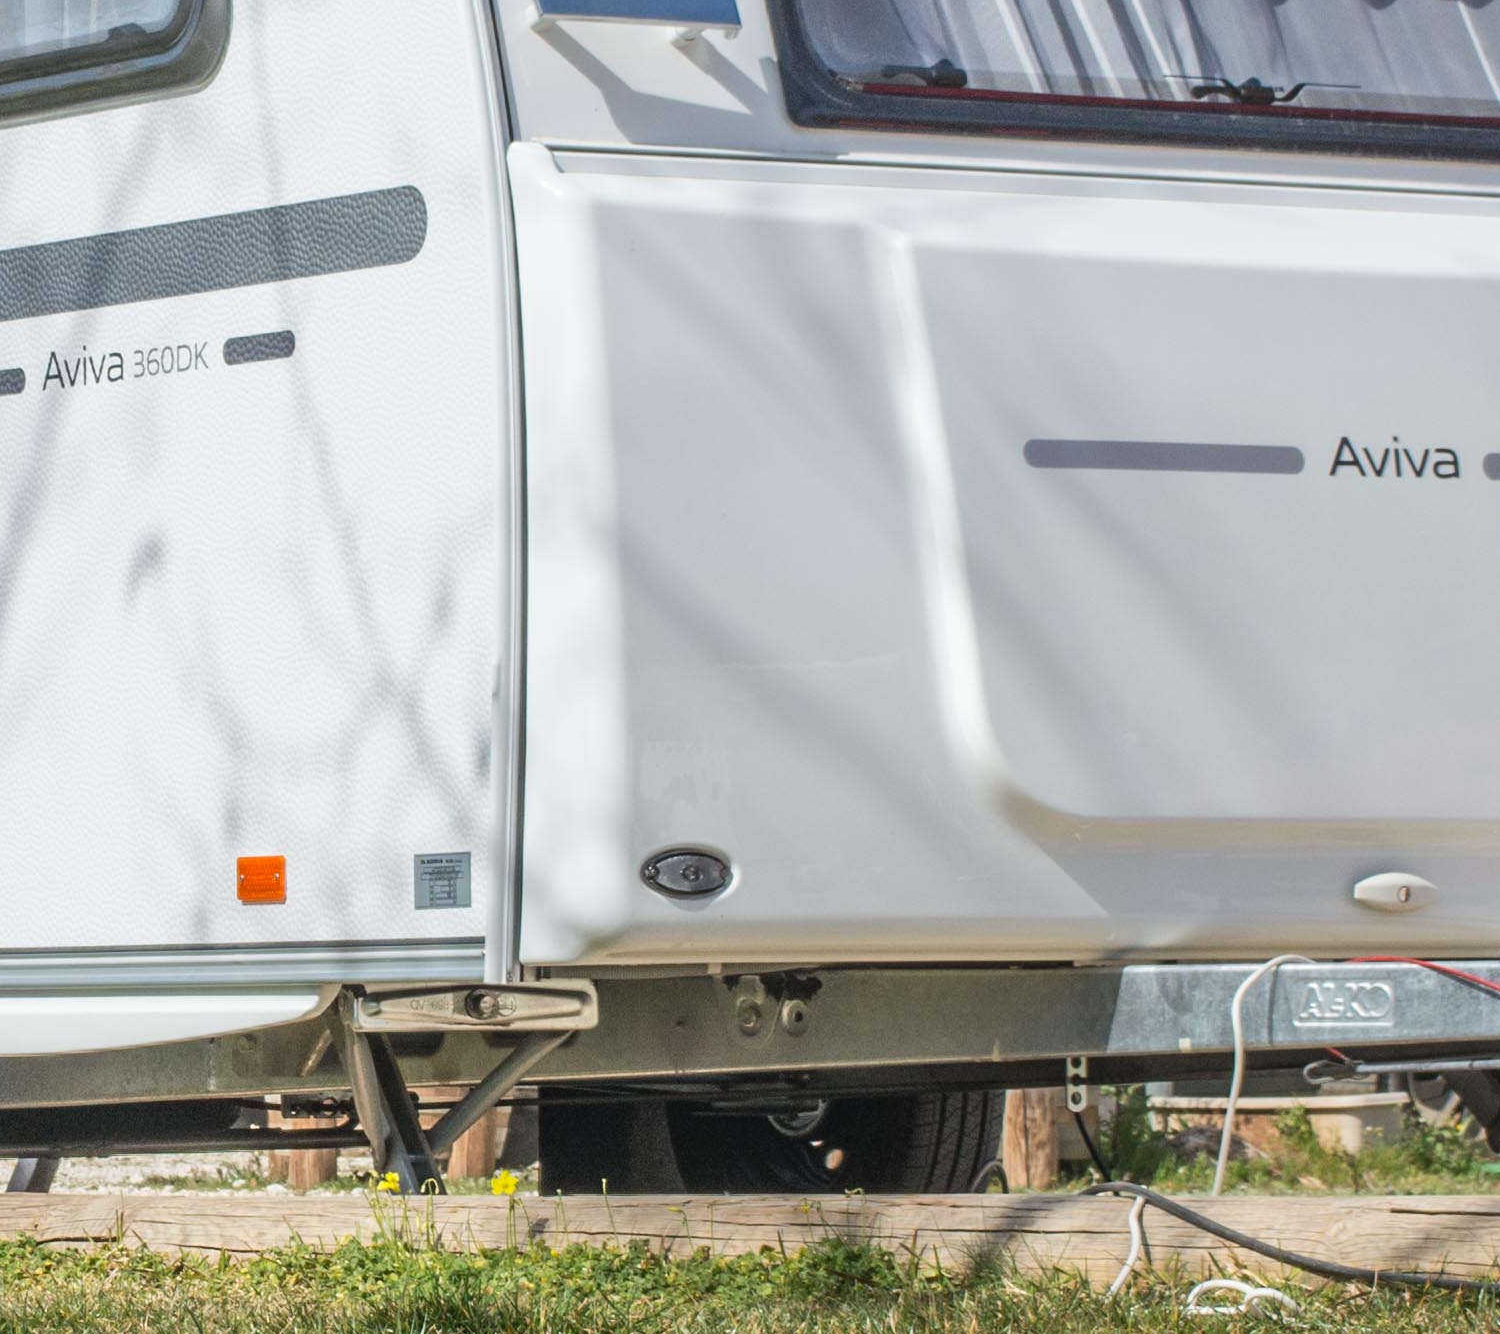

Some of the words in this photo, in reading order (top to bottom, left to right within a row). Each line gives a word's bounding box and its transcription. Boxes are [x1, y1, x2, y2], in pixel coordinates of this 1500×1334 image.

[42, 345, 124, 392] Aviva
[133, 341, 209, 379] 360DK
[1329, 436, 1461, 479] Aviva
